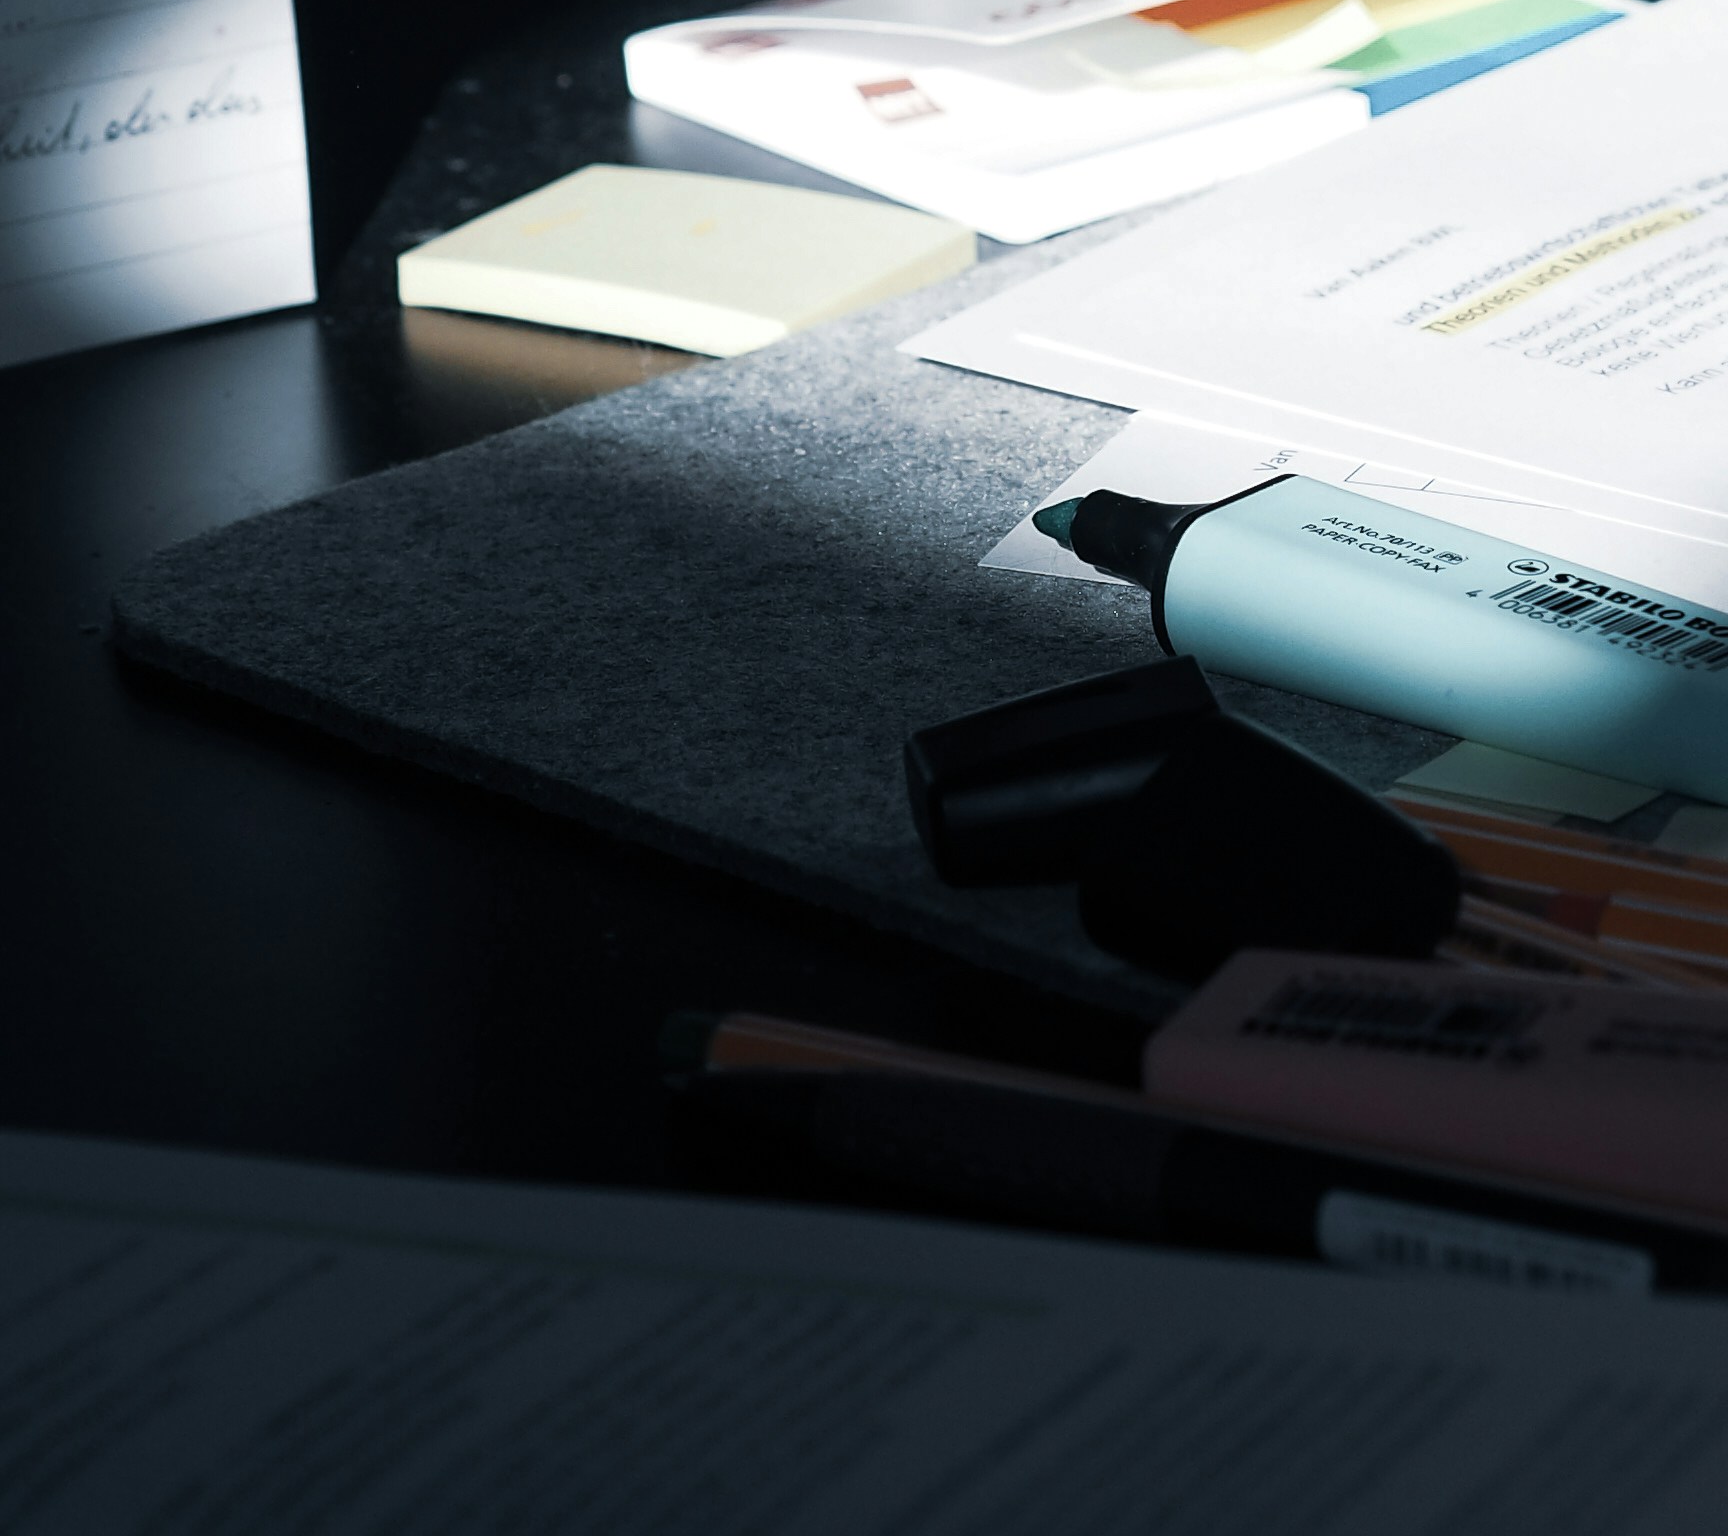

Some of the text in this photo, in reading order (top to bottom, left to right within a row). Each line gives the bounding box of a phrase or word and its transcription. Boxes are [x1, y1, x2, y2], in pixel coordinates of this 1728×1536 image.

[1656, 366, 1724, 395] Kann
[1253, 449, 1300, 473] Van
[1549, 573, 1687, 622] STABILO
